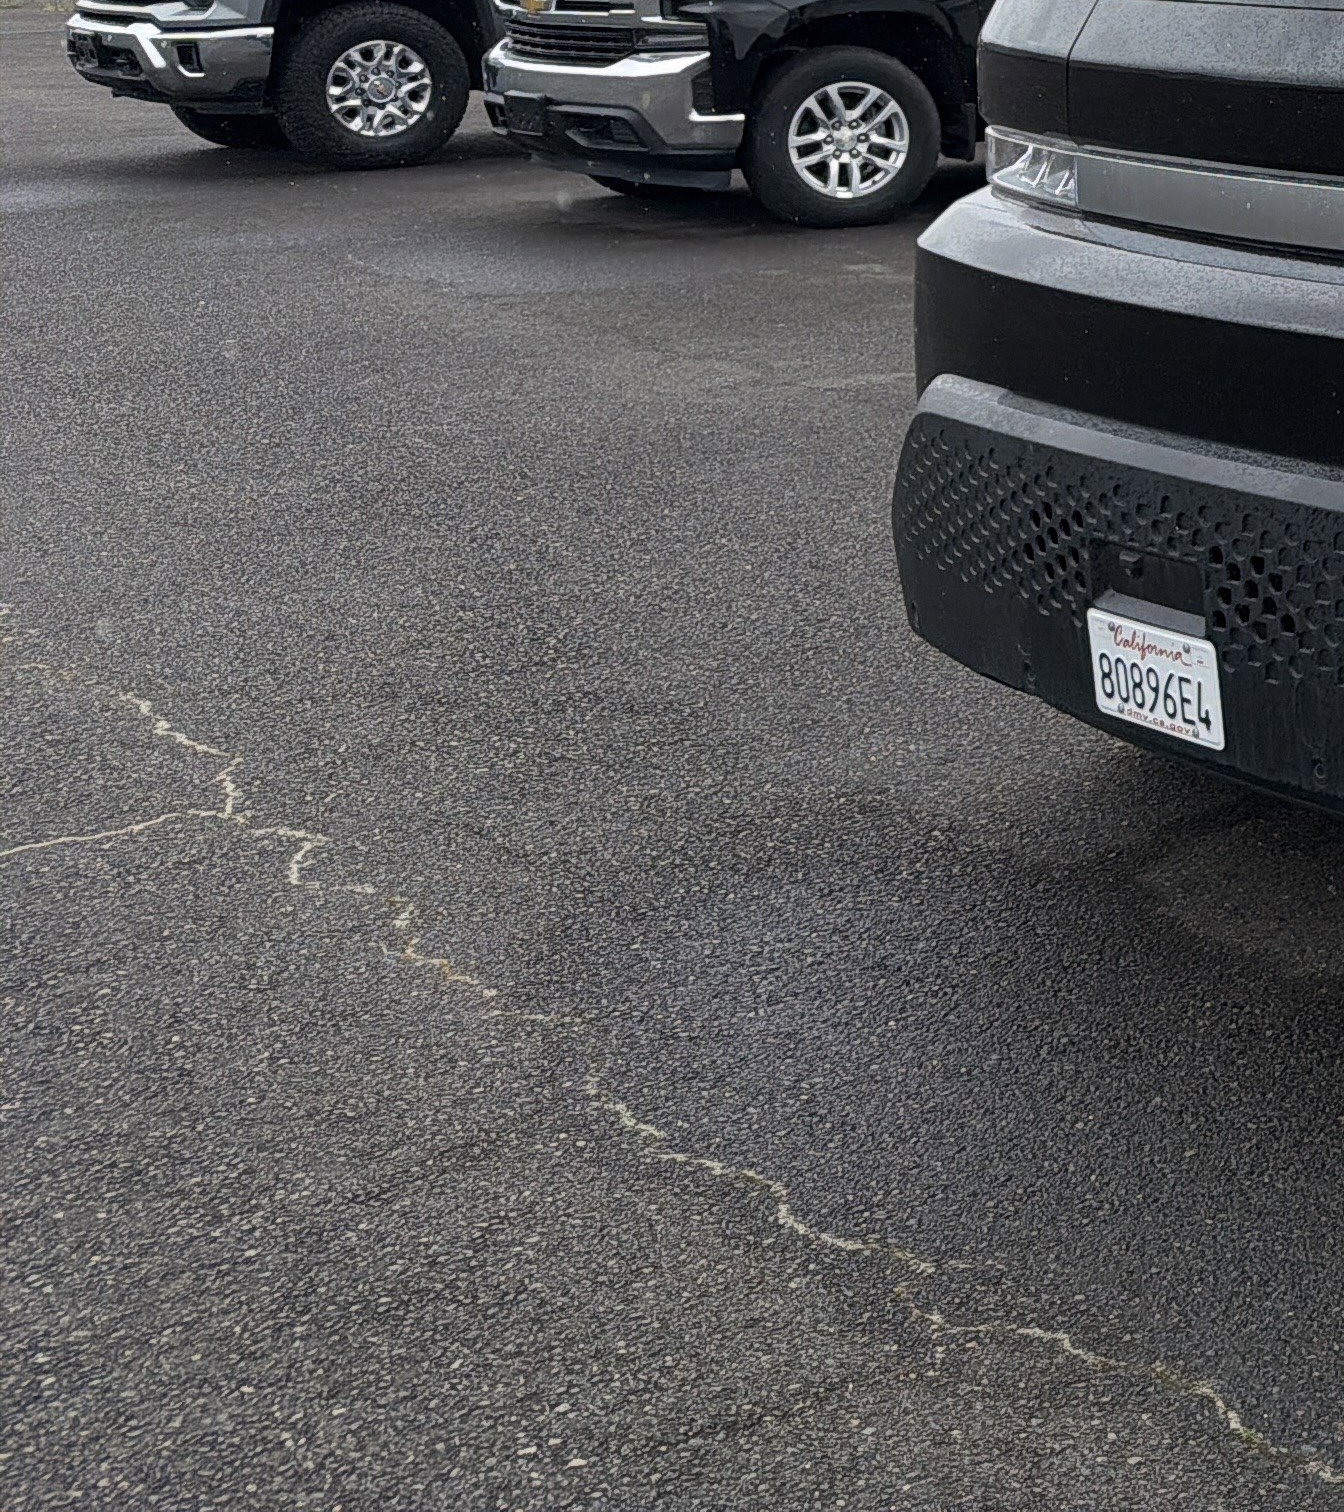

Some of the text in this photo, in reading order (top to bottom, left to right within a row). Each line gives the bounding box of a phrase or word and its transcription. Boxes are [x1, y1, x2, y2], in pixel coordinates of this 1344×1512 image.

[1113, 624, 1192, 667] California
[1099, 652, 1211, 732] 80896E4
[1126, 707, 1191, 736] dmv.ca.gov
